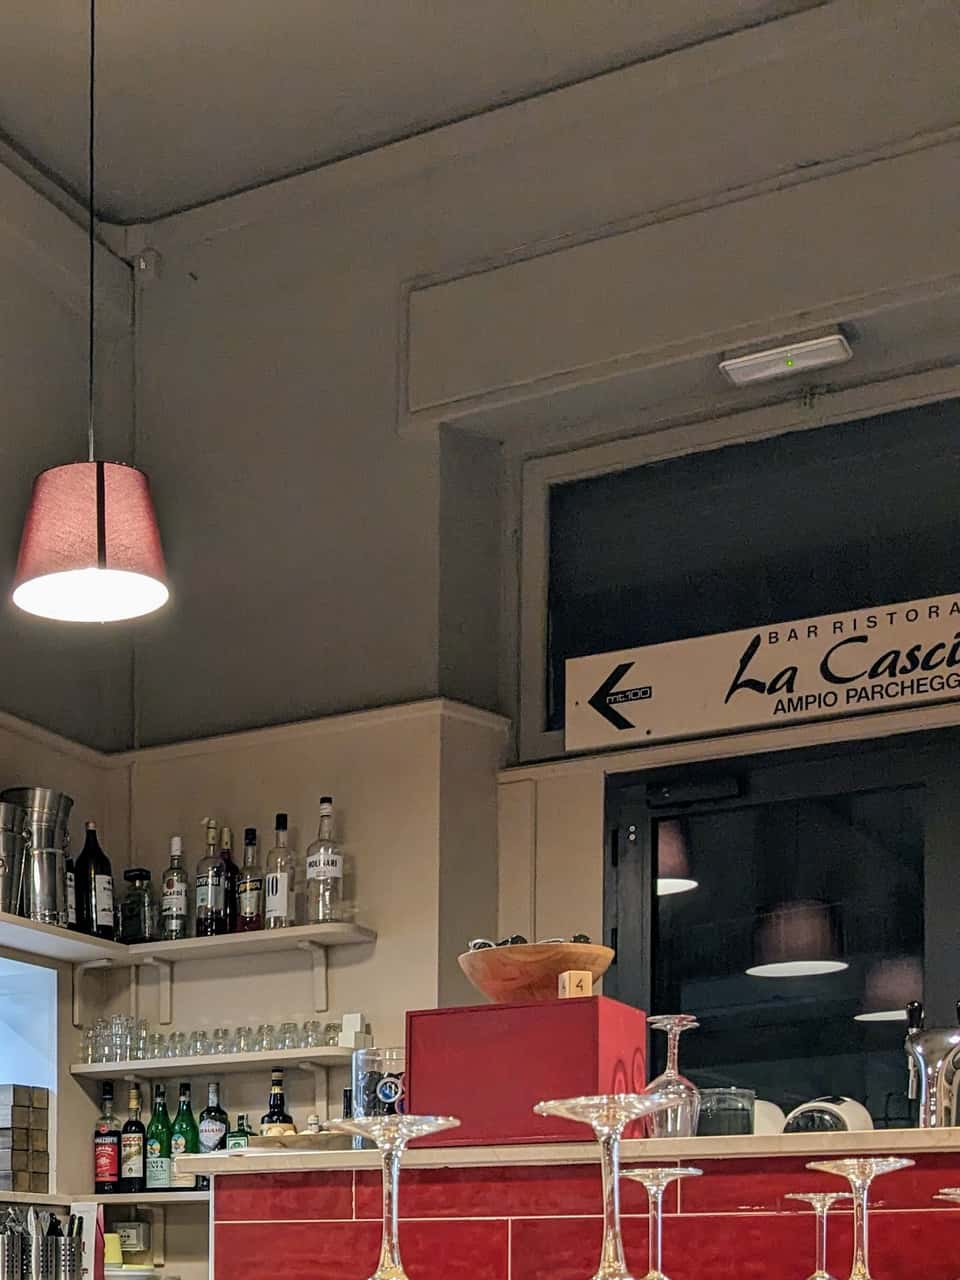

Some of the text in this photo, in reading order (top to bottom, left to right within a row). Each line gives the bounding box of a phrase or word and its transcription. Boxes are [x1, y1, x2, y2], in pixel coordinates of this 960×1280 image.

[768, 602, 960, 645] BAR RISTORA
[724, 633, 798, 705] La
[773, 672, 960, 715] AMPIO PARCHEGG
[575, 977, 584, 993] 4
